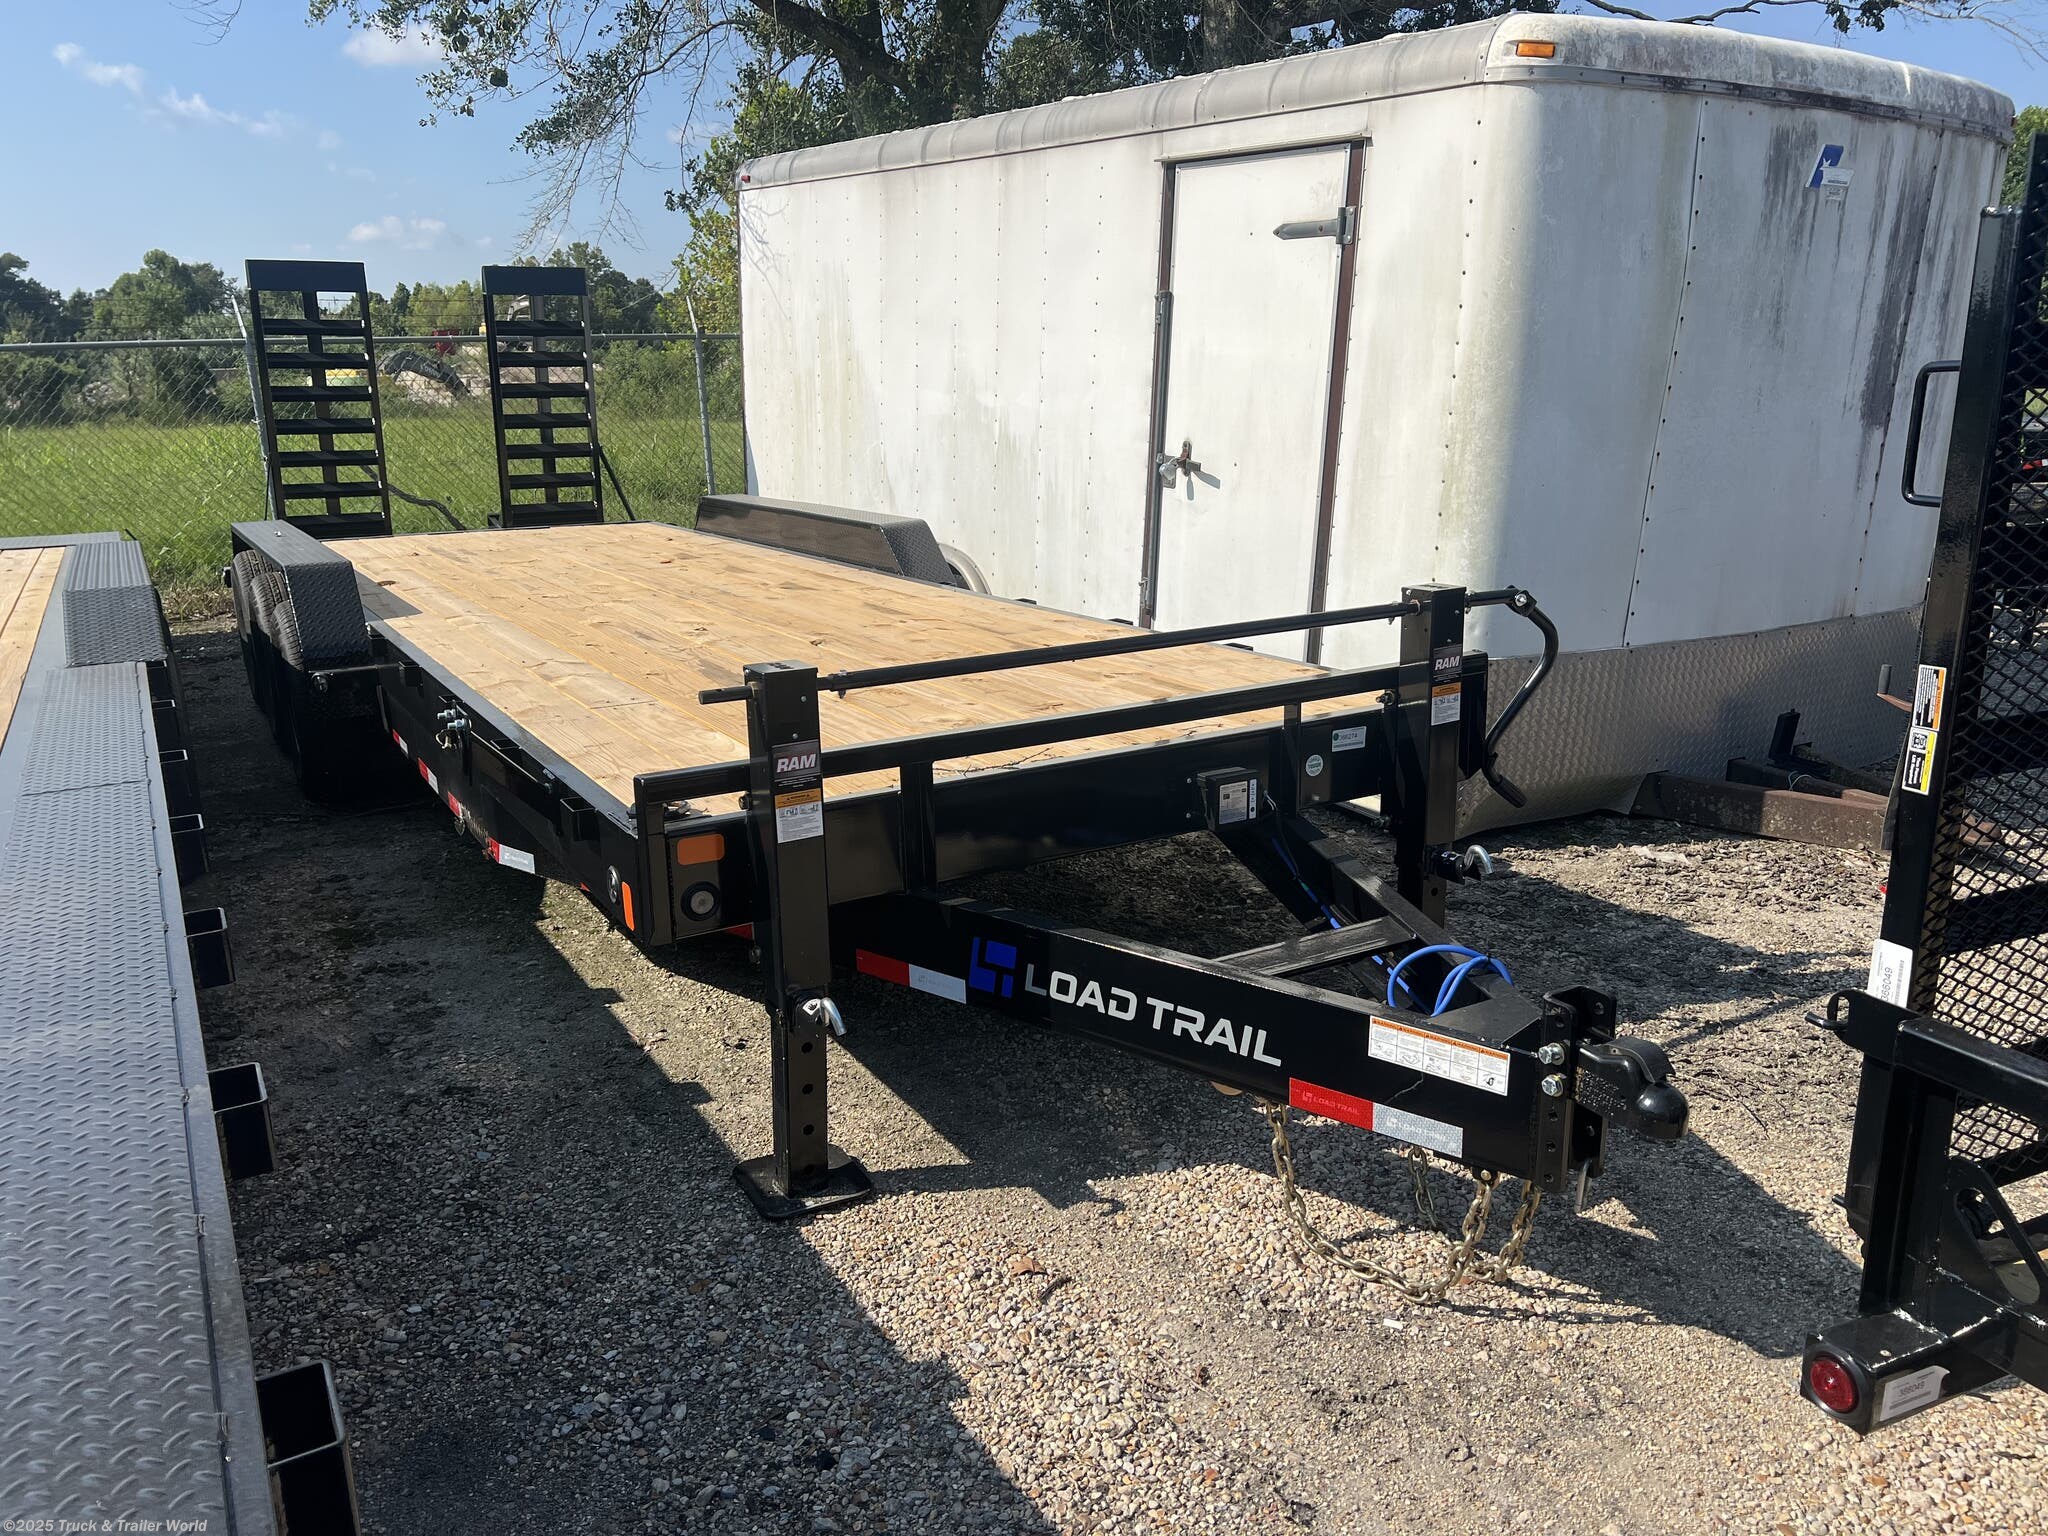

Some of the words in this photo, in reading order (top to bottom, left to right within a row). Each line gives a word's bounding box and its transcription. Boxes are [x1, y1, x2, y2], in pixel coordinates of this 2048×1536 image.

[1434, 655, 1460, 671] RAM
[776, 753, 816, 773] RAM
[1024, 963, 1137, 1021] LOAD
[1146, 996, 1282, 1067] TRAIL
